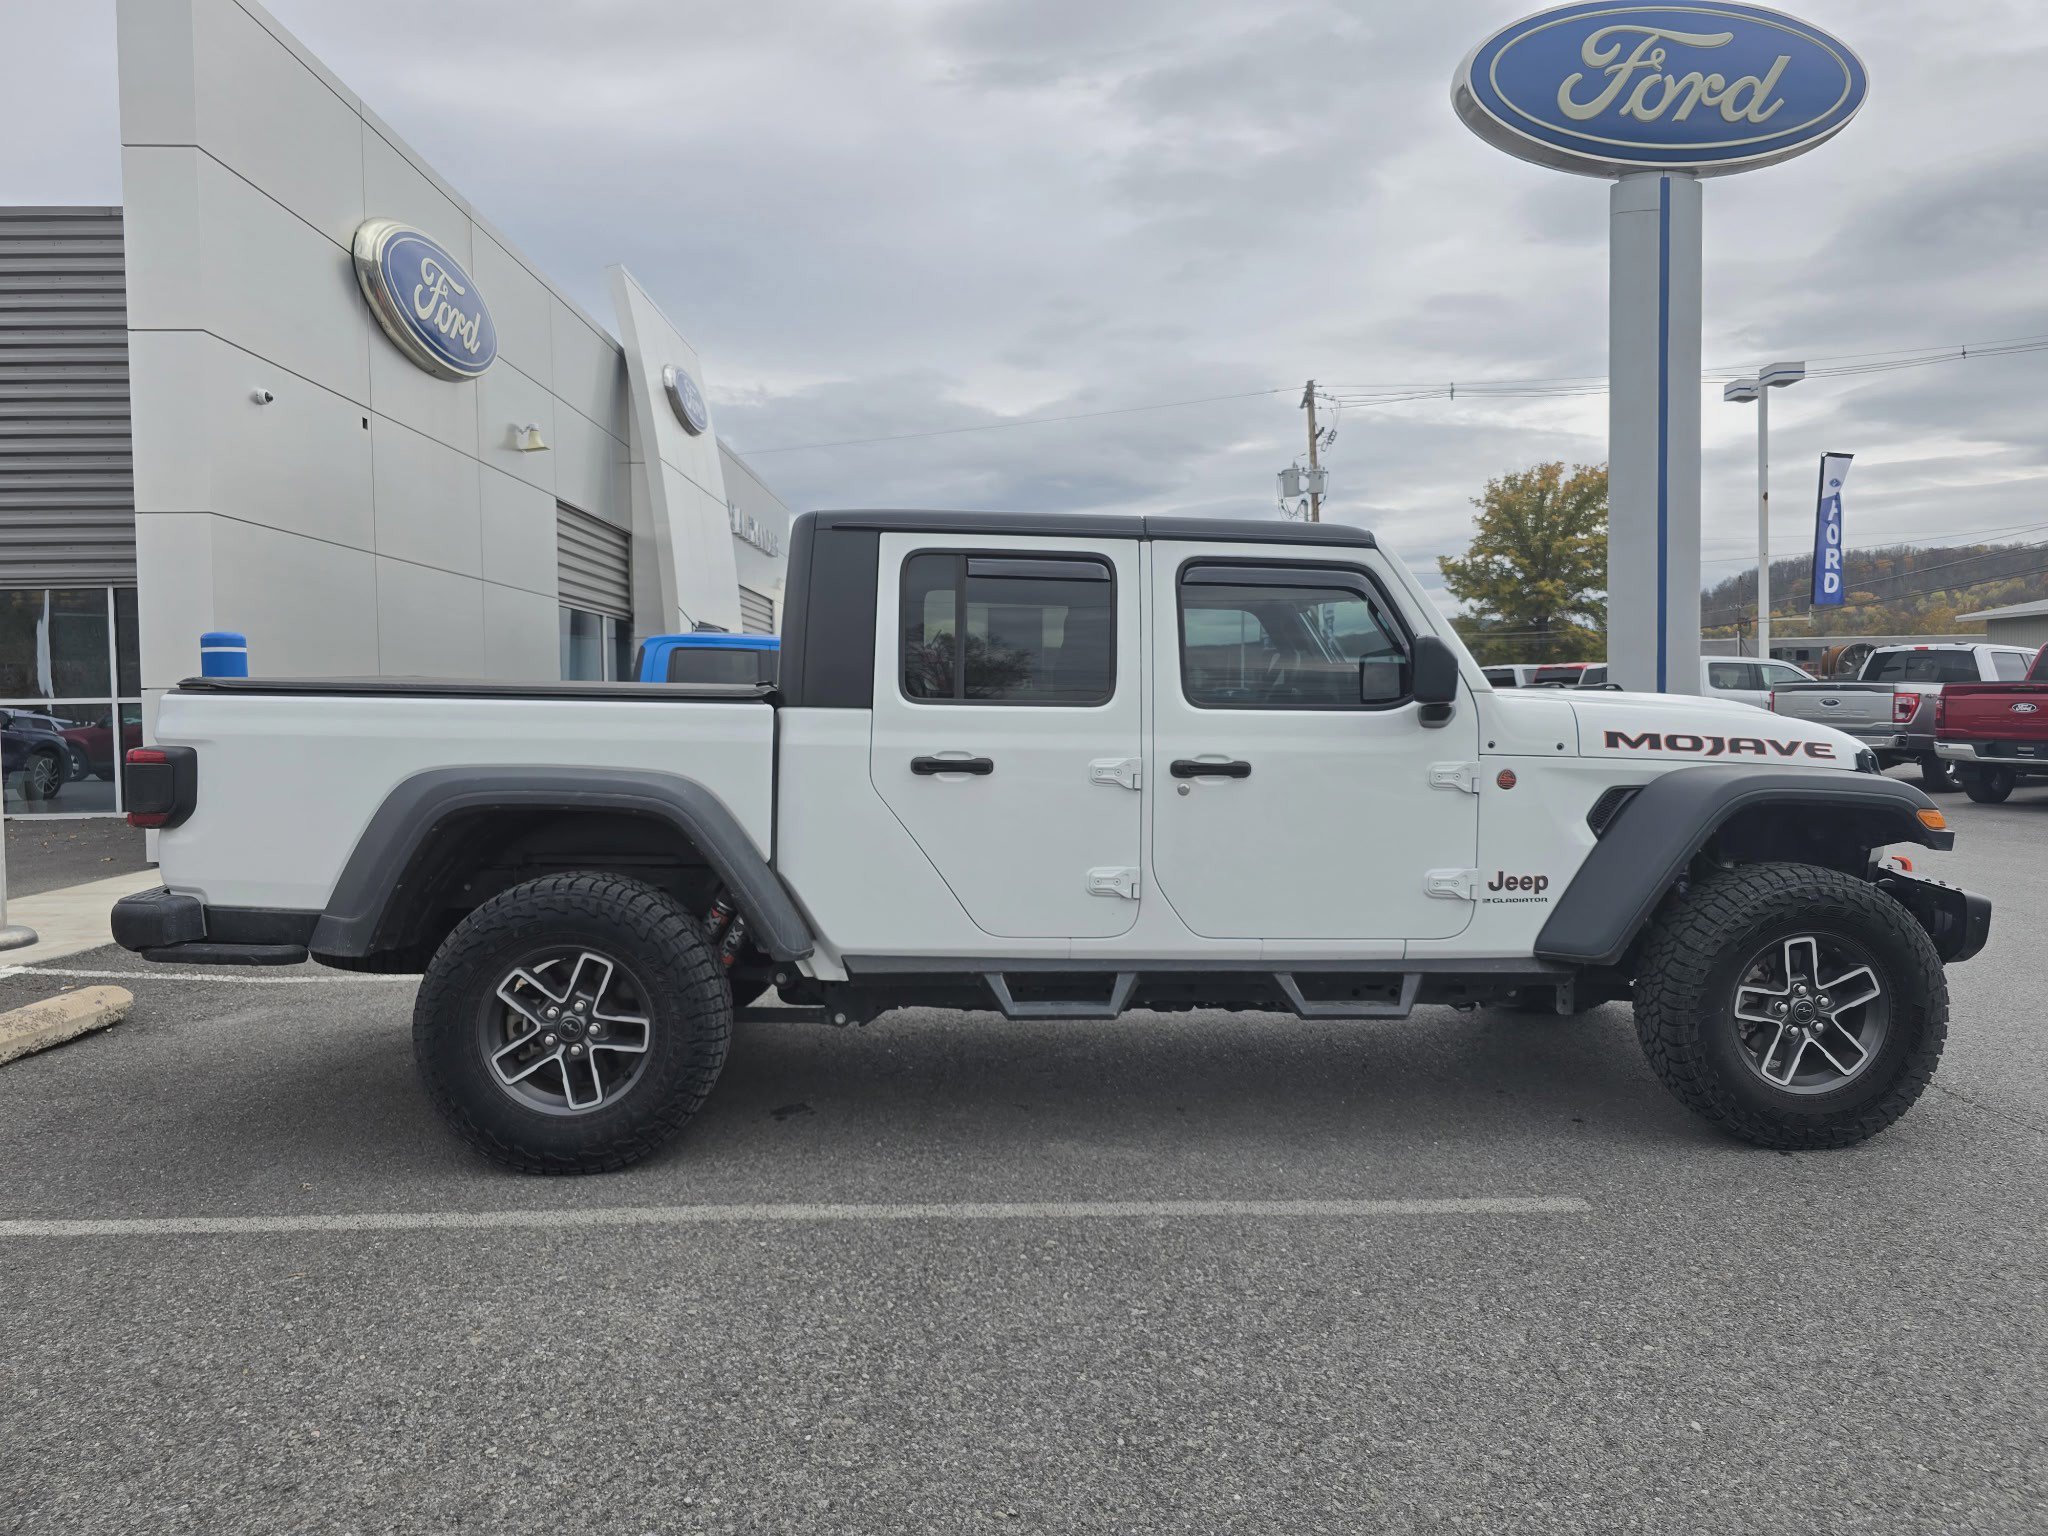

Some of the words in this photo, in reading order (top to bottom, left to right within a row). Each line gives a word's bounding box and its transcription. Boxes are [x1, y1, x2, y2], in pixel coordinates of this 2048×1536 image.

[1557, 25, 1791, 123] Ford
[414, 258, 481, 354] Ford
[1603, 730, 1837, 760] MOJAVE
[1488, 871, 1549, 894] Jeep
